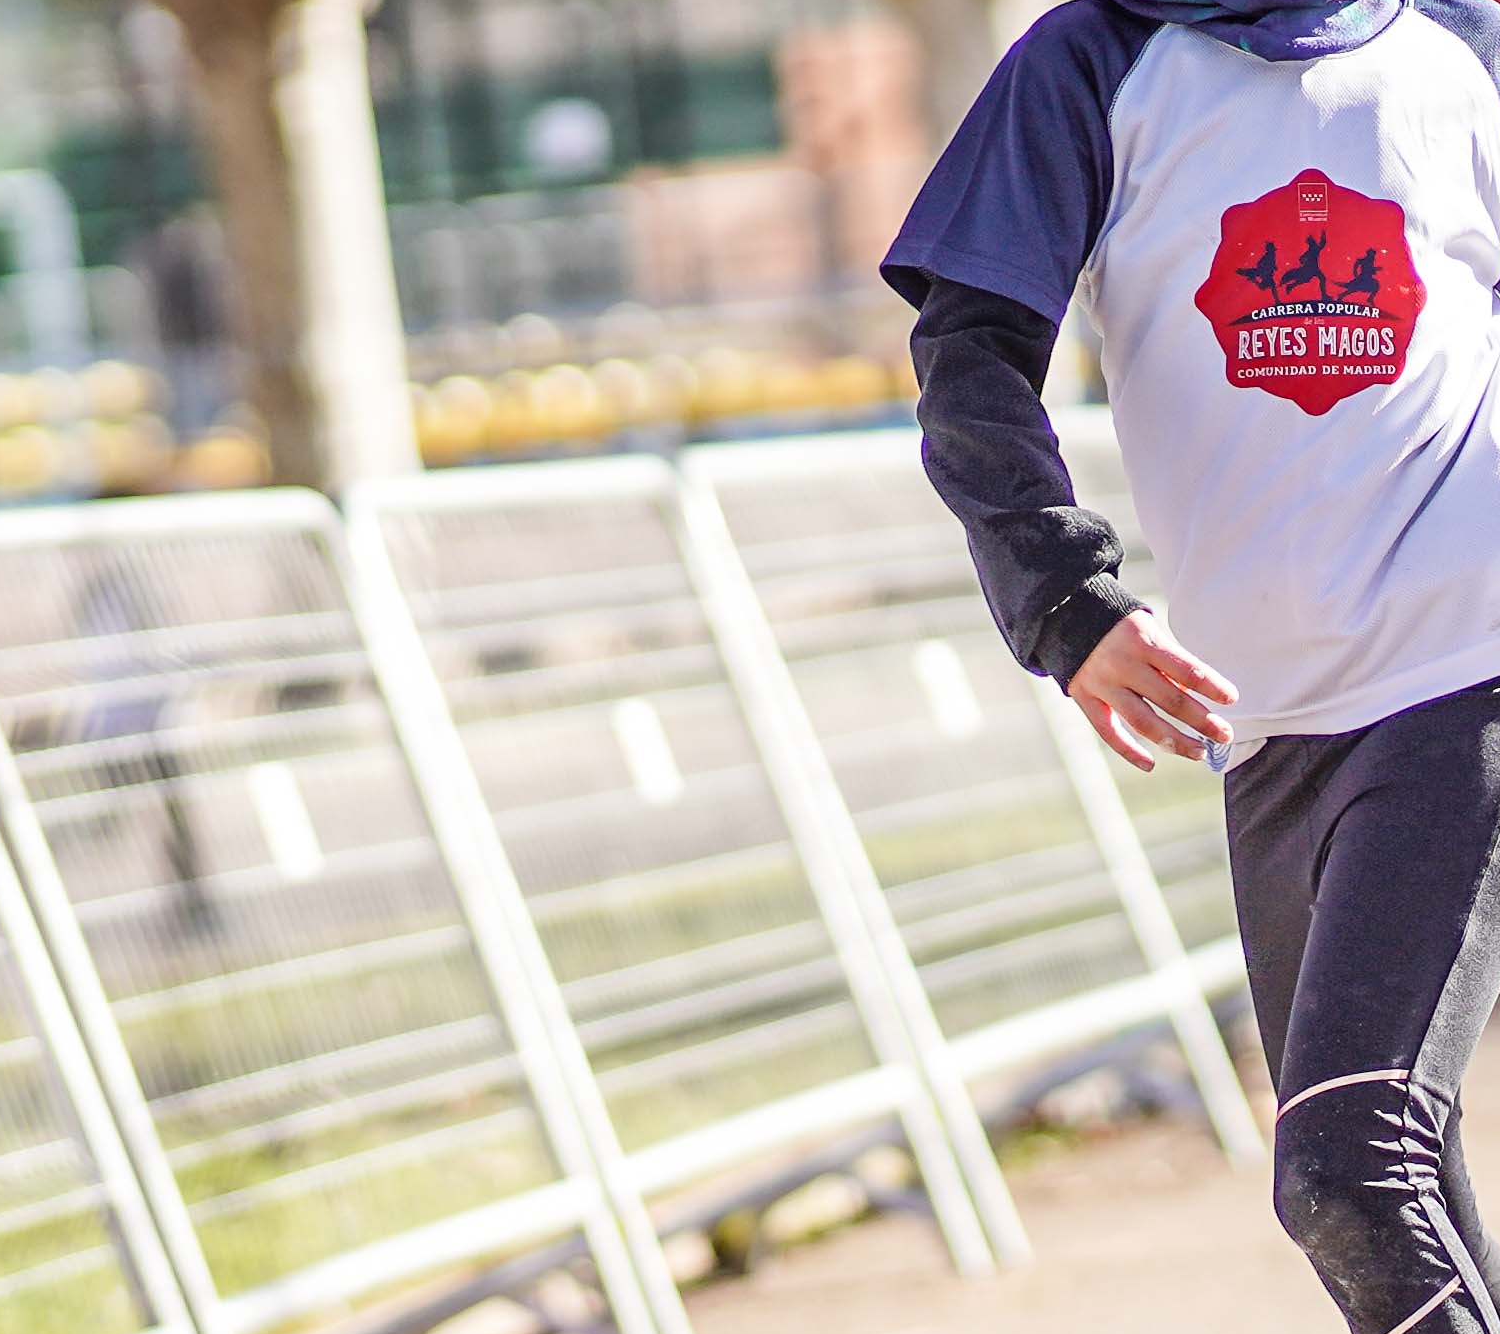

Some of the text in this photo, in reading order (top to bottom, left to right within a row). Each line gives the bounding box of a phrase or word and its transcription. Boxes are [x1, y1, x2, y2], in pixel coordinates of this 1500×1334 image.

[1251, 302, 1380, 320] CARRERA POPULAR
[1238, 327, 1395, 360] REYES MAGOS
[1237, 365, 1397, 379] COMUNIDAD DE MADRID
